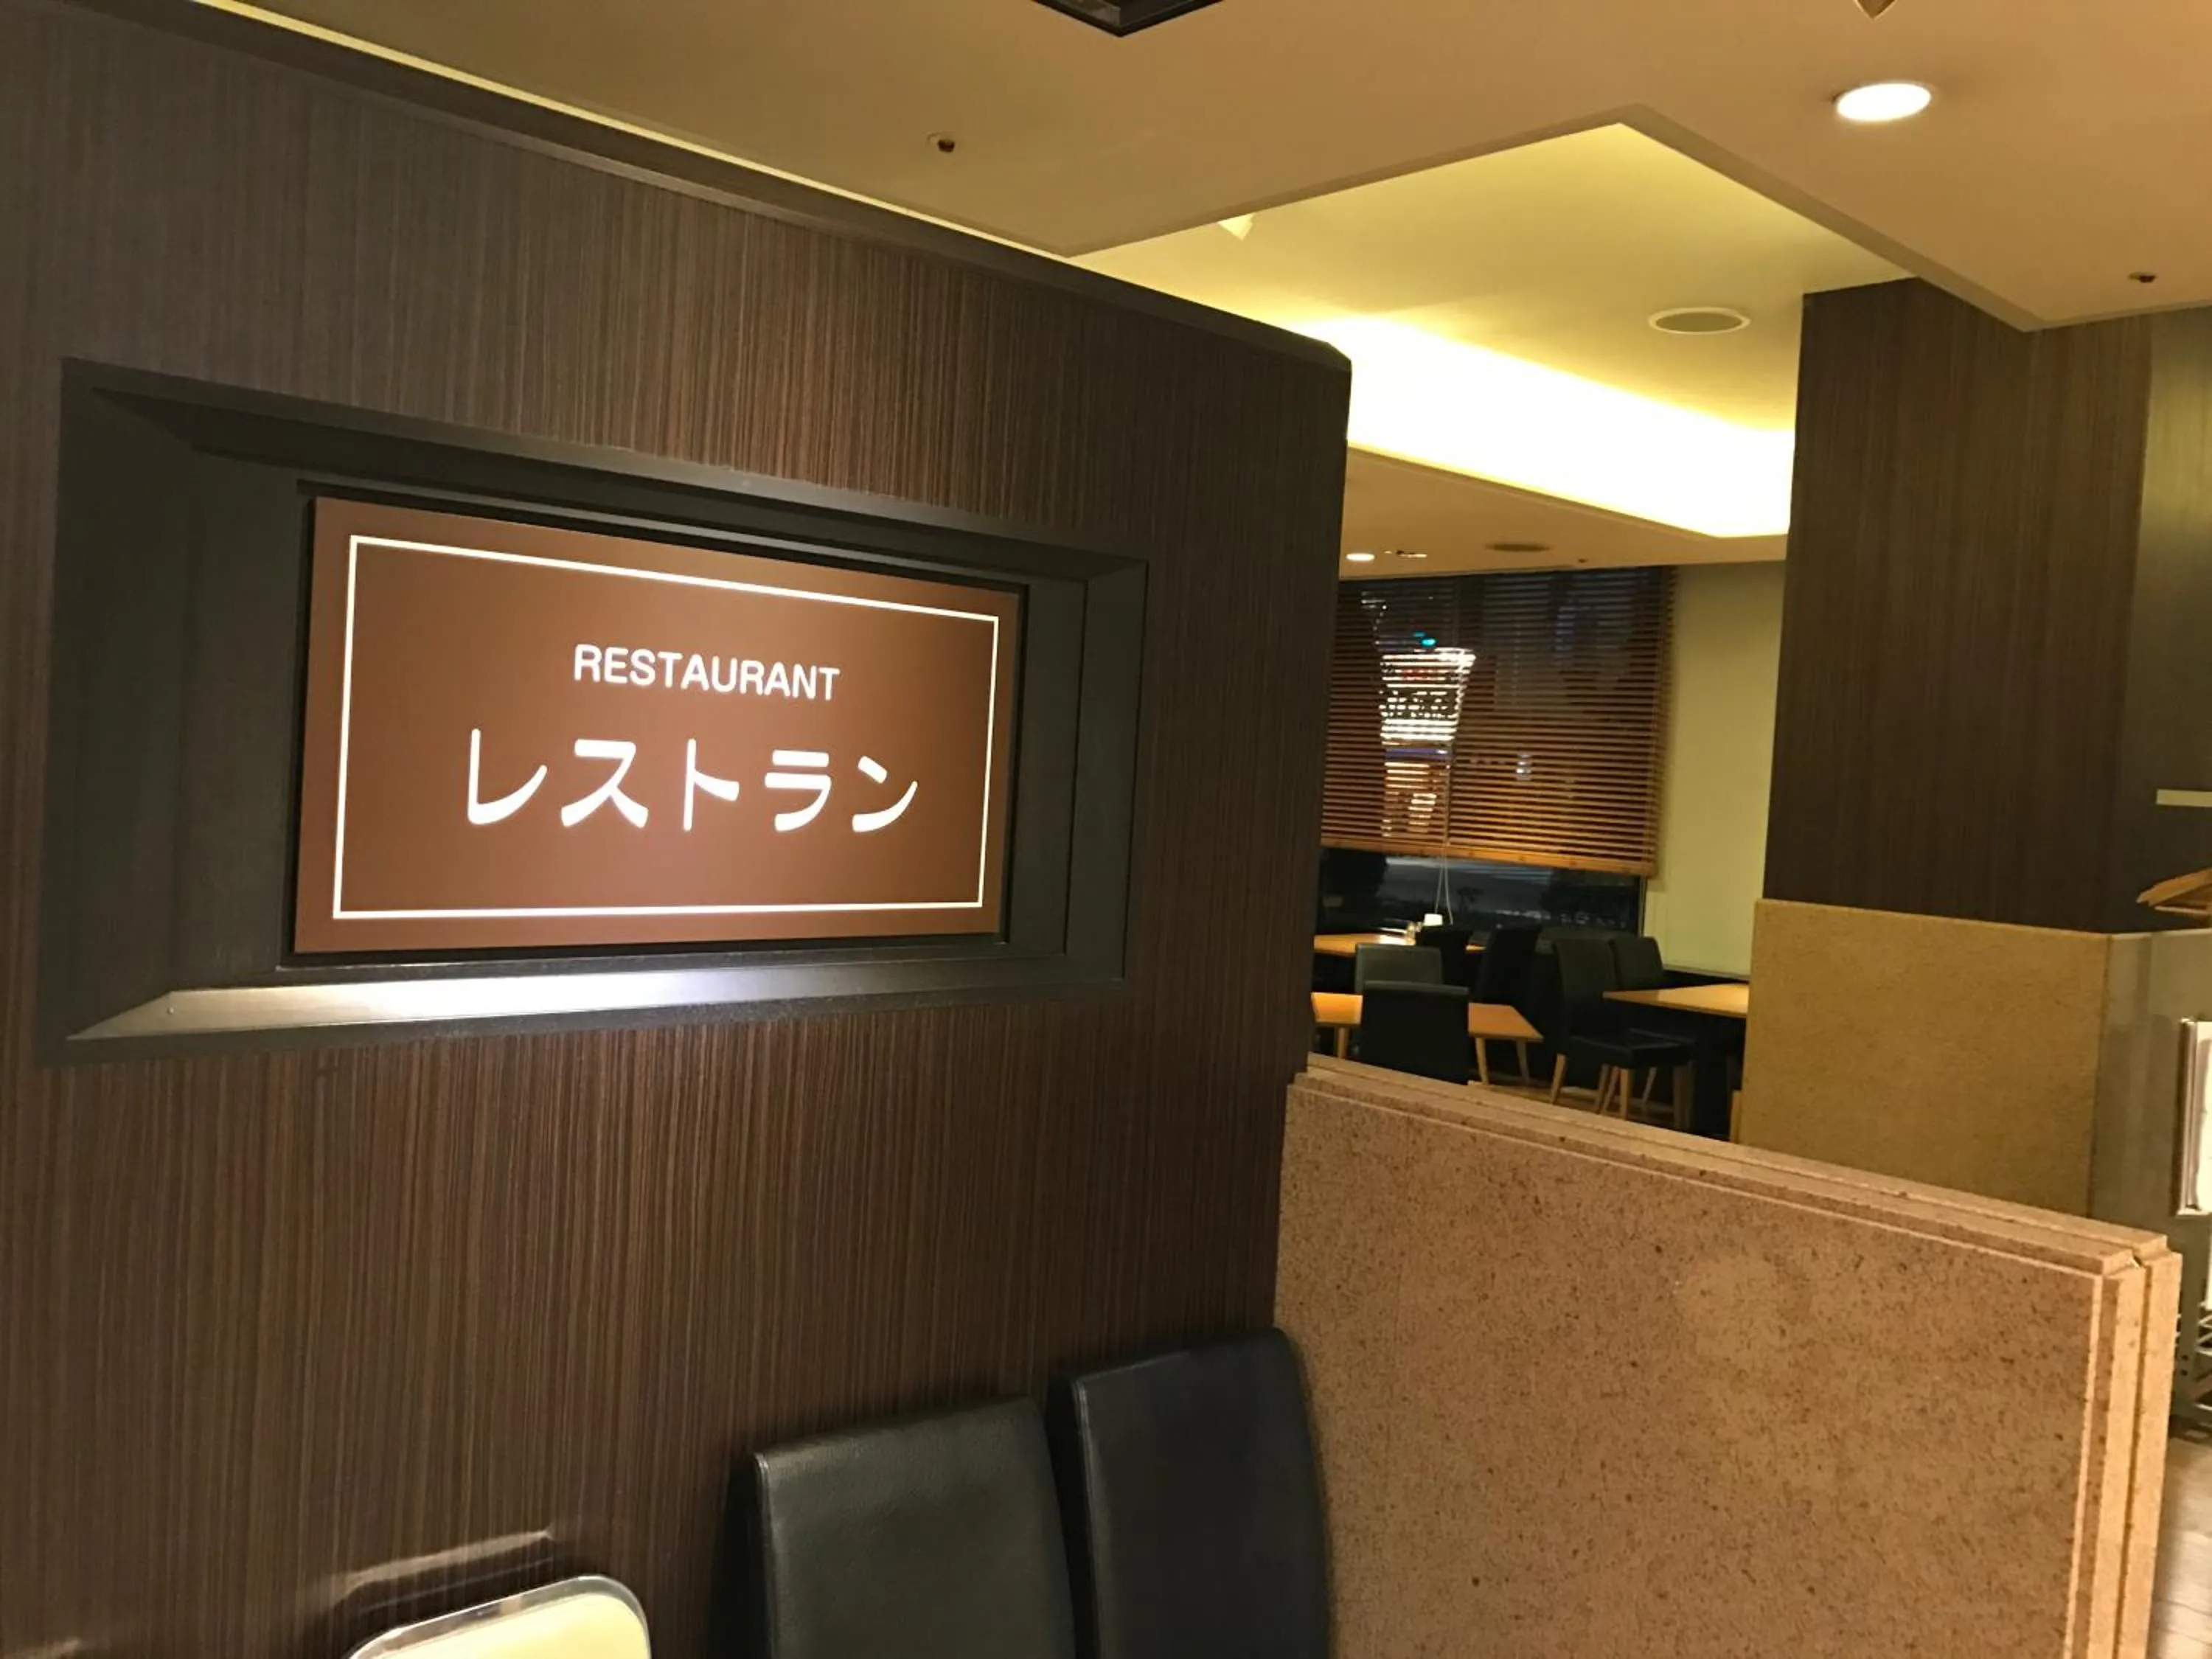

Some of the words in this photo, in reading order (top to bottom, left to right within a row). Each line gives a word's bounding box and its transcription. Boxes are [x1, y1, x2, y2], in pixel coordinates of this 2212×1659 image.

[573, 643, 841, 701] RESTAURANT
[466, 727, 919, 834] レストラン
